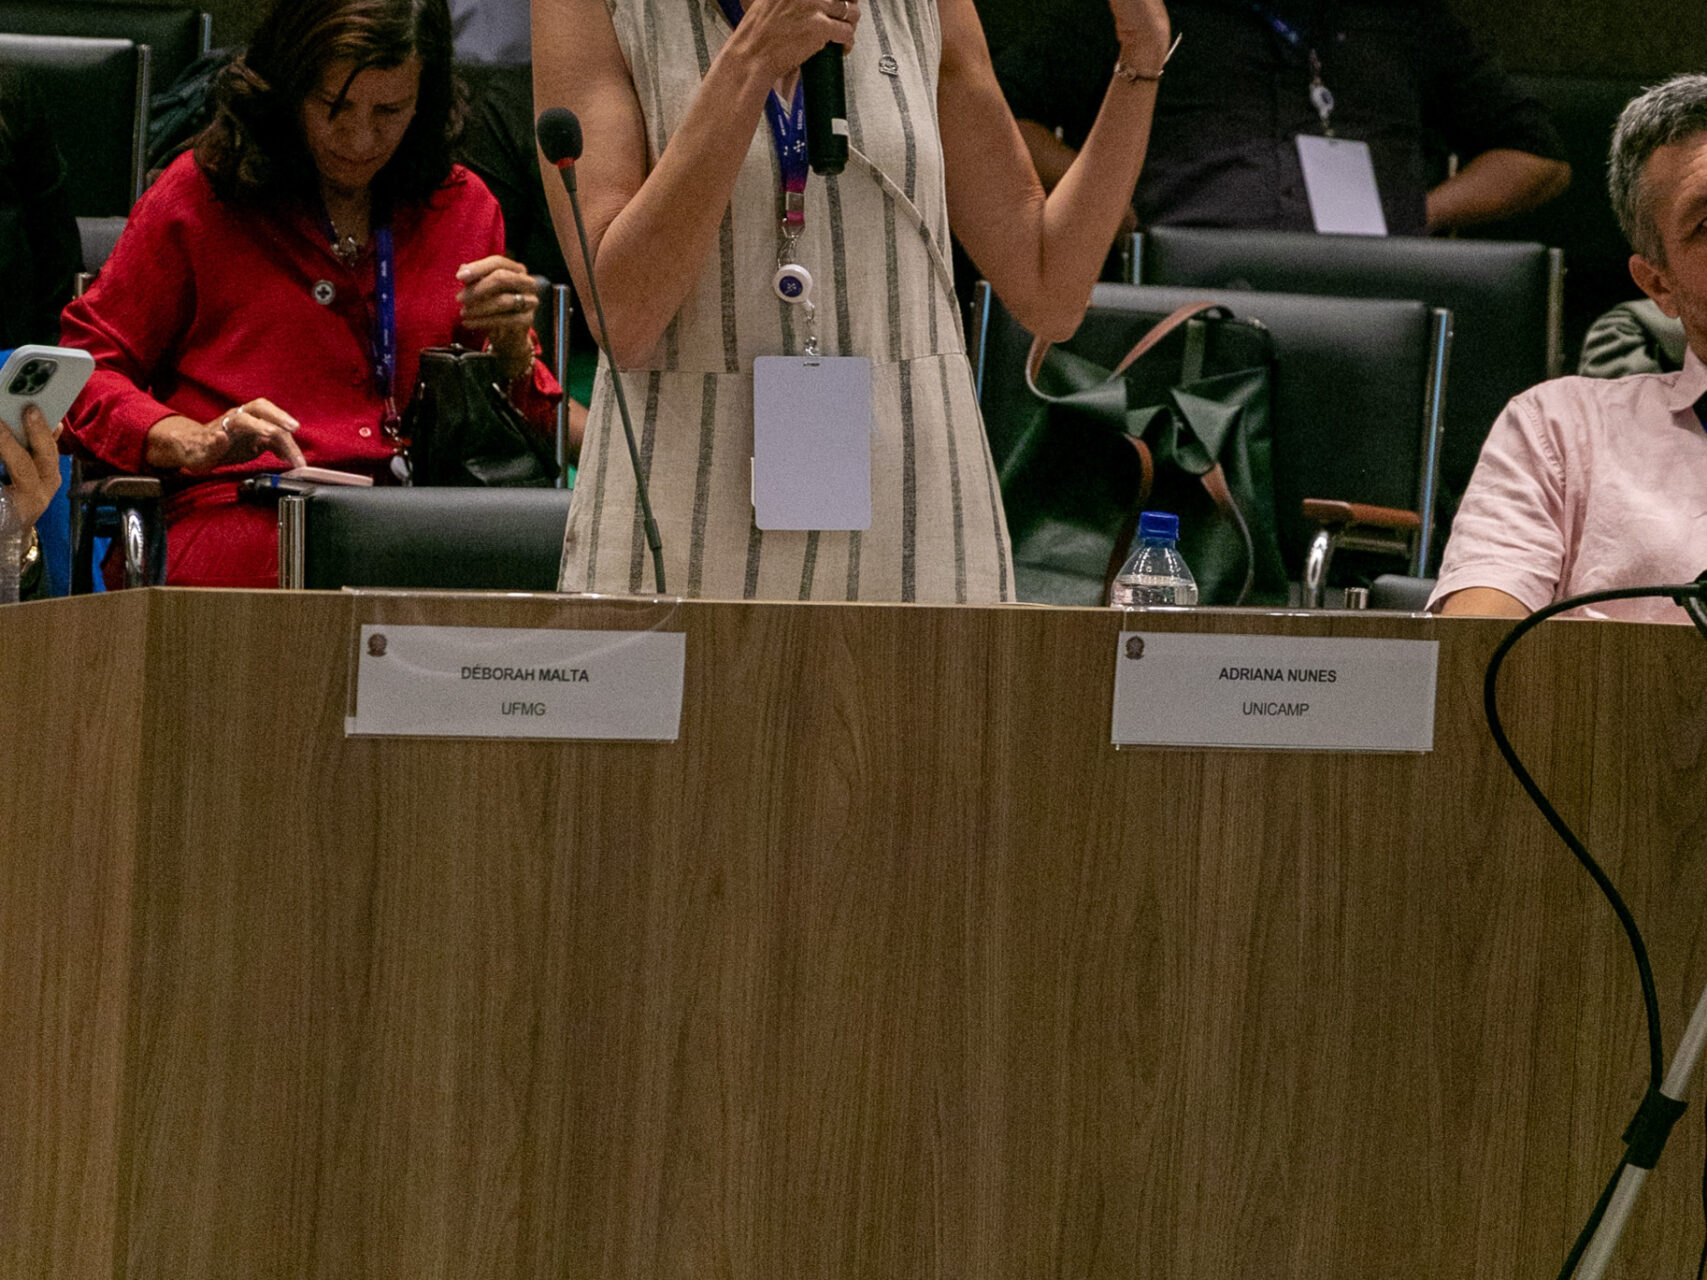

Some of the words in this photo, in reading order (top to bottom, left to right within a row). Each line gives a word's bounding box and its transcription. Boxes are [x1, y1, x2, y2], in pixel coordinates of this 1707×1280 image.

[461, 664, 535, 680] DÉBORAH
[538, 669, 590, 682] MALTA
[1218, 667, 1284, 681] ADRIANA
[1287, 668, 1337, 683] NUNES
[501, 702, 546, 716] UFMG
[1242, 701, 1310, 716] UNICAMP
